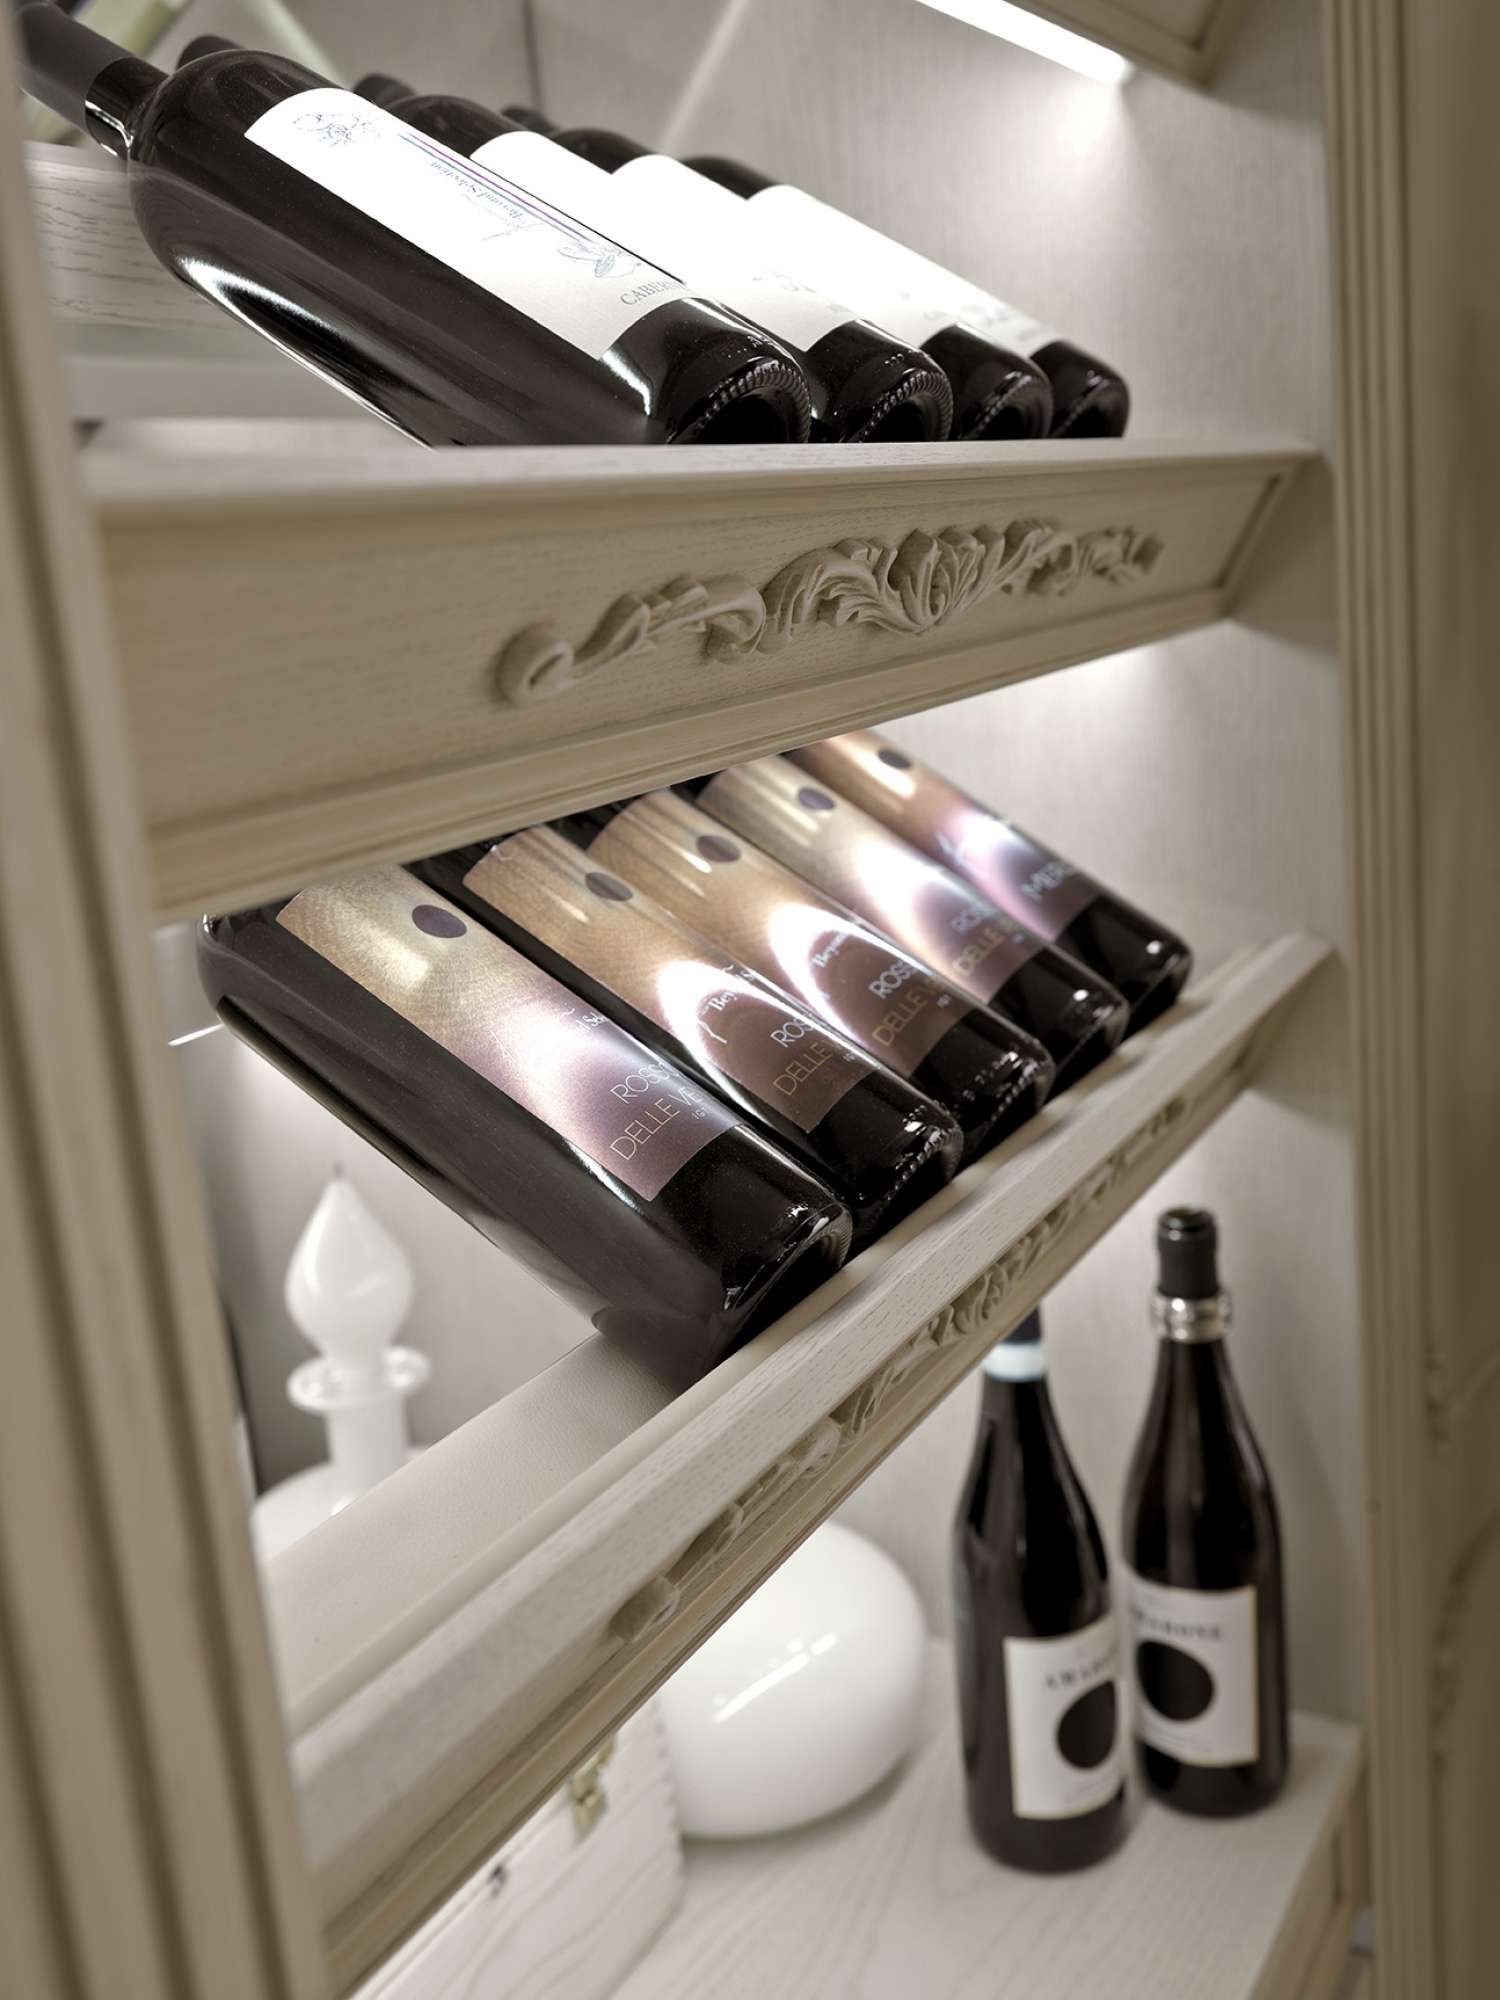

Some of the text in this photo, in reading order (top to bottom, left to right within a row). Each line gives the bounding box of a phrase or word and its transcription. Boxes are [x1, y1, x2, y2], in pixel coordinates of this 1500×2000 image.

[872, 991, 928, 1047] DELLE
[772, 1041, 833, 1096] DELLE
[610, 1098, 681, 1161] DELLE
